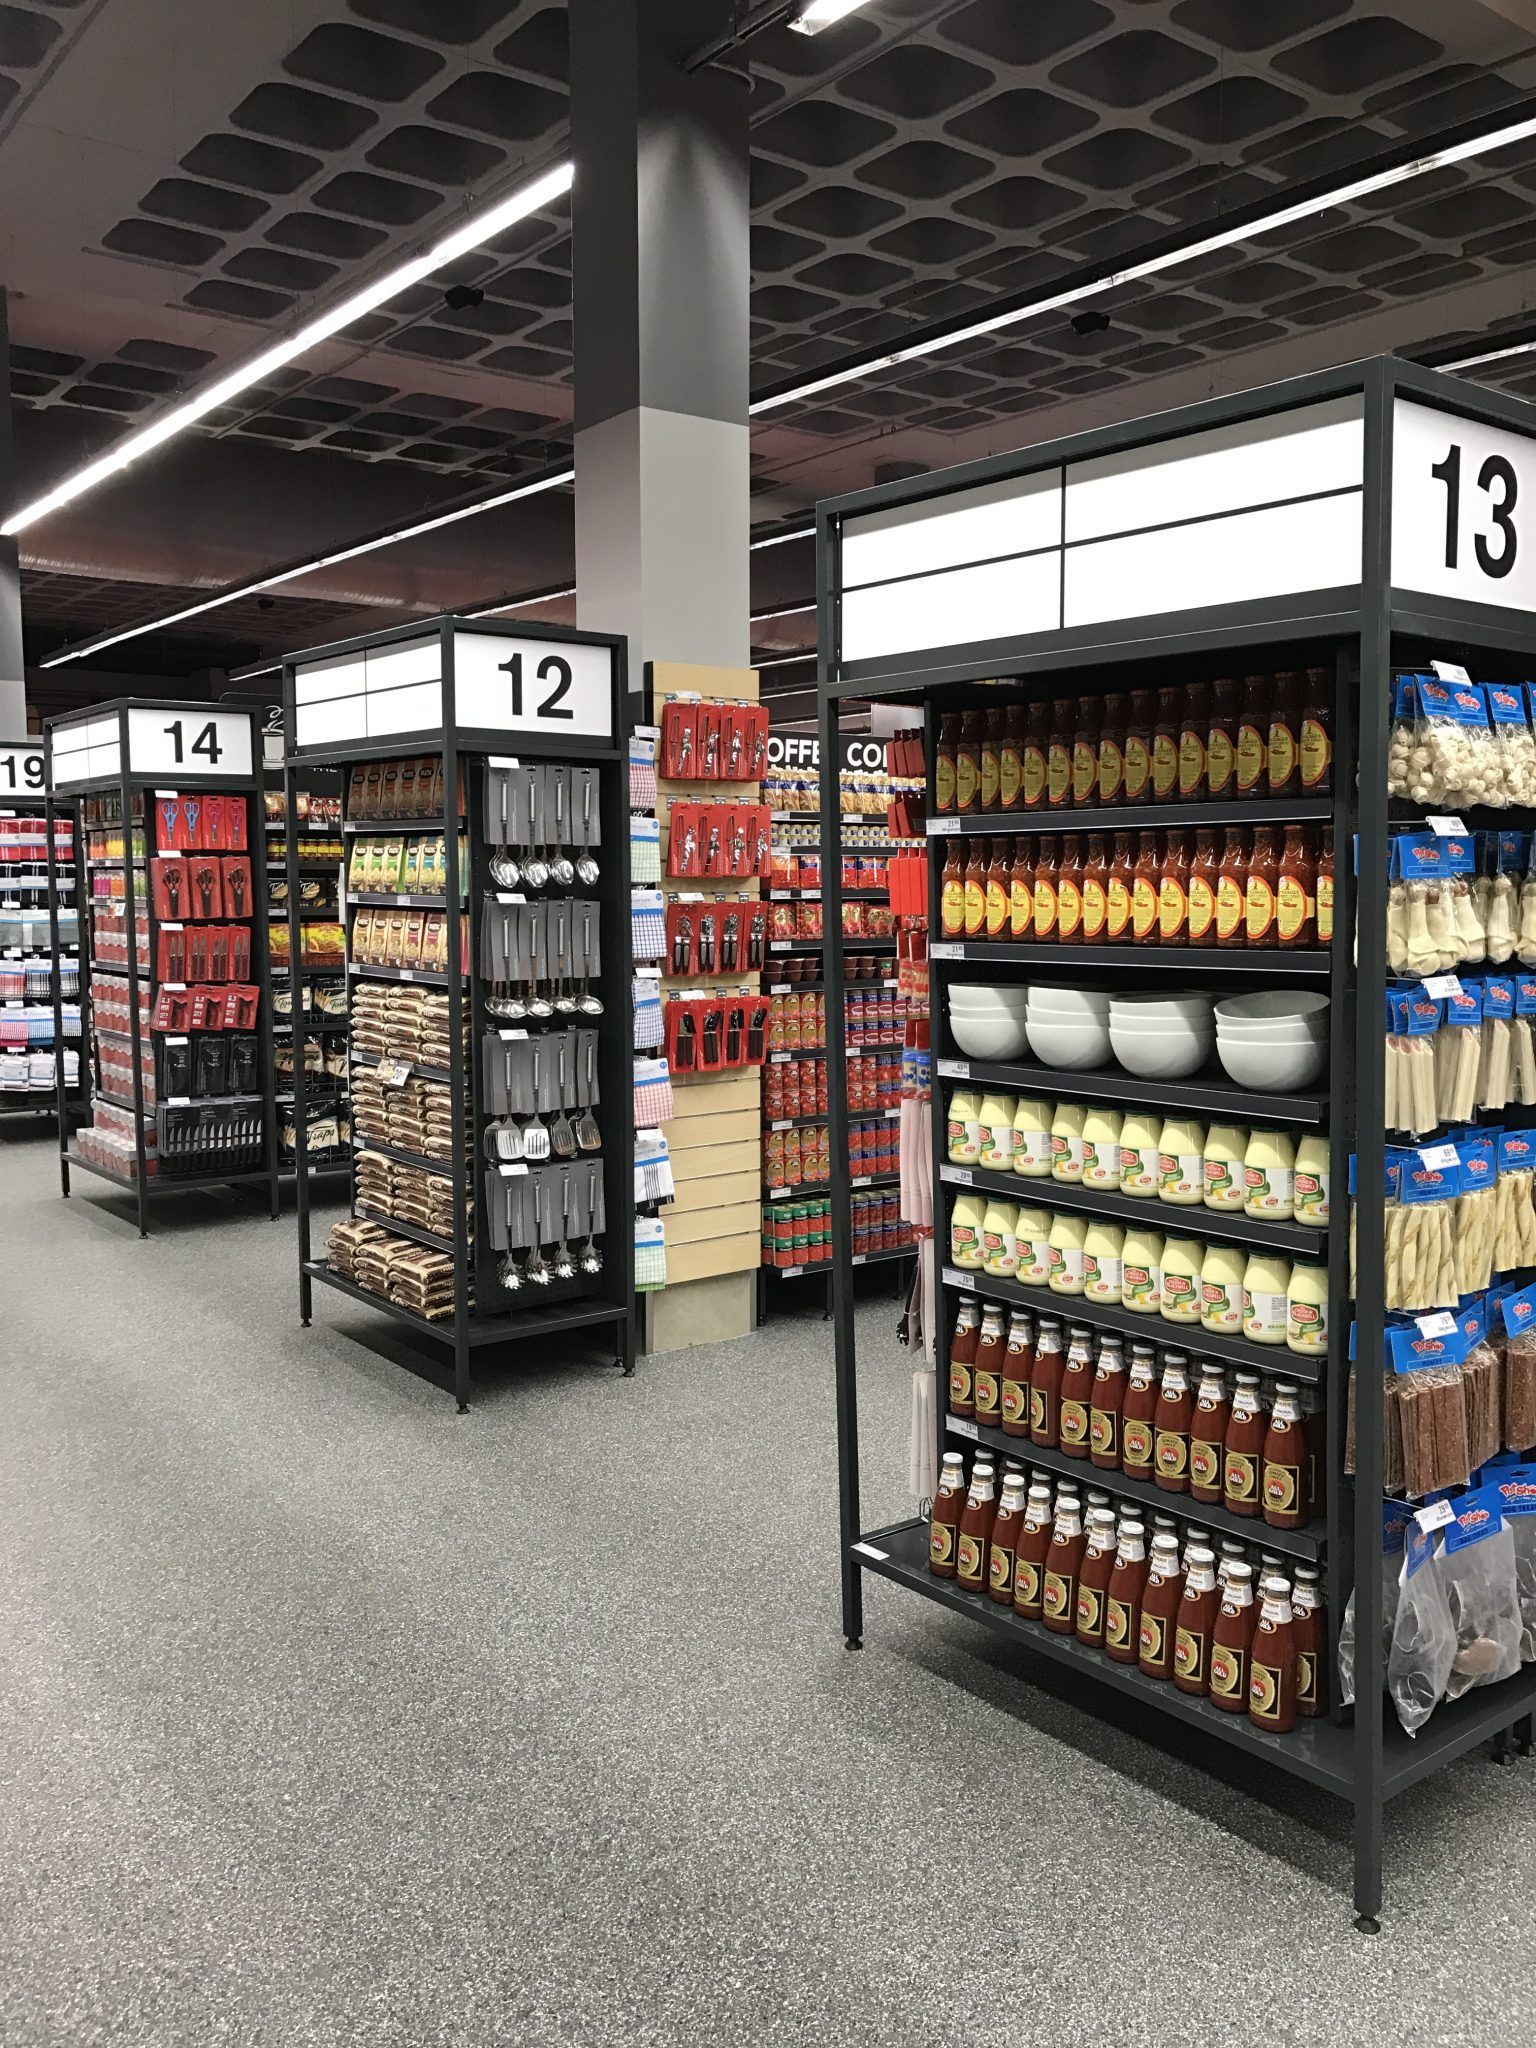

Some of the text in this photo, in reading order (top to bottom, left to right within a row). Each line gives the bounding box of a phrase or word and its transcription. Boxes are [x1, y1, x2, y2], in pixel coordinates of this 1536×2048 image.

[1432, 444, 1518, 579] 13
[499, 652, 574, 720] 12
[164, 720, 223, 764] 14
[0, 755, 45, 788] 19
